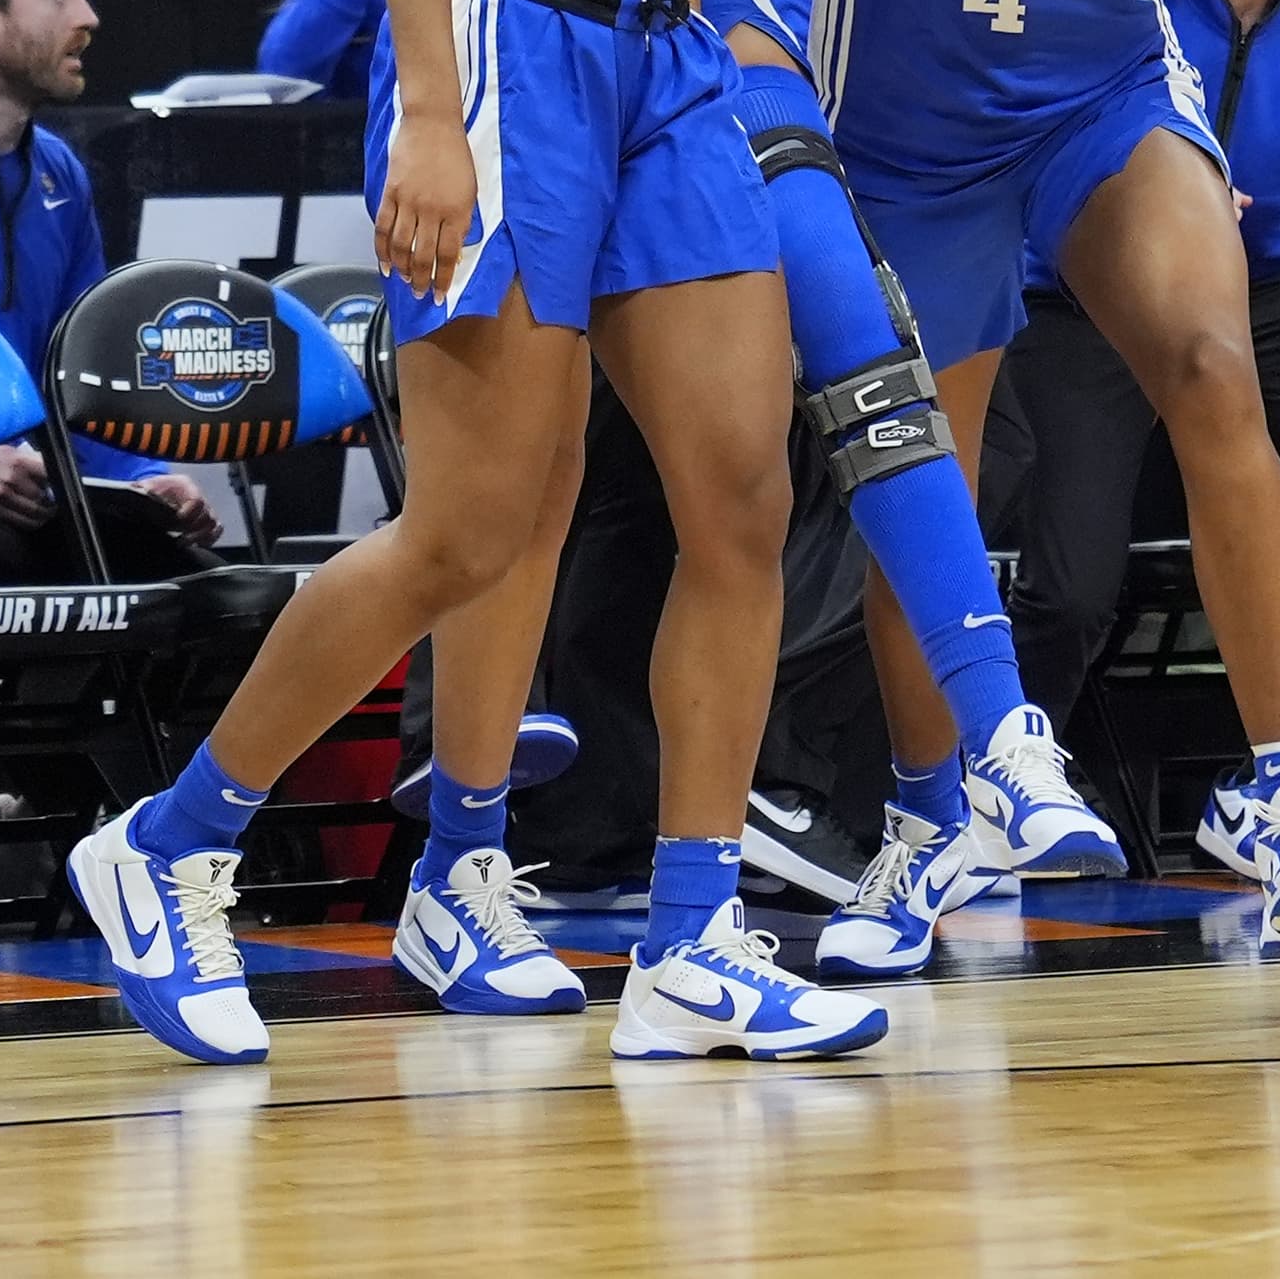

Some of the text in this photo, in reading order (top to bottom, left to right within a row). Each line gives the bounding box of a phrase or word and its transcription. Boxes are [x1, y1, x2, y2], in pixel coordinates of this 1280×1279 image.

[161, 326, 232, 352] MARCH
[174, 349, 271, 375] MADNESS
[40, 596, 74, 633] IT
[76, 594, 129, 632] ALL
[1023, 710, 1045, 737] D
